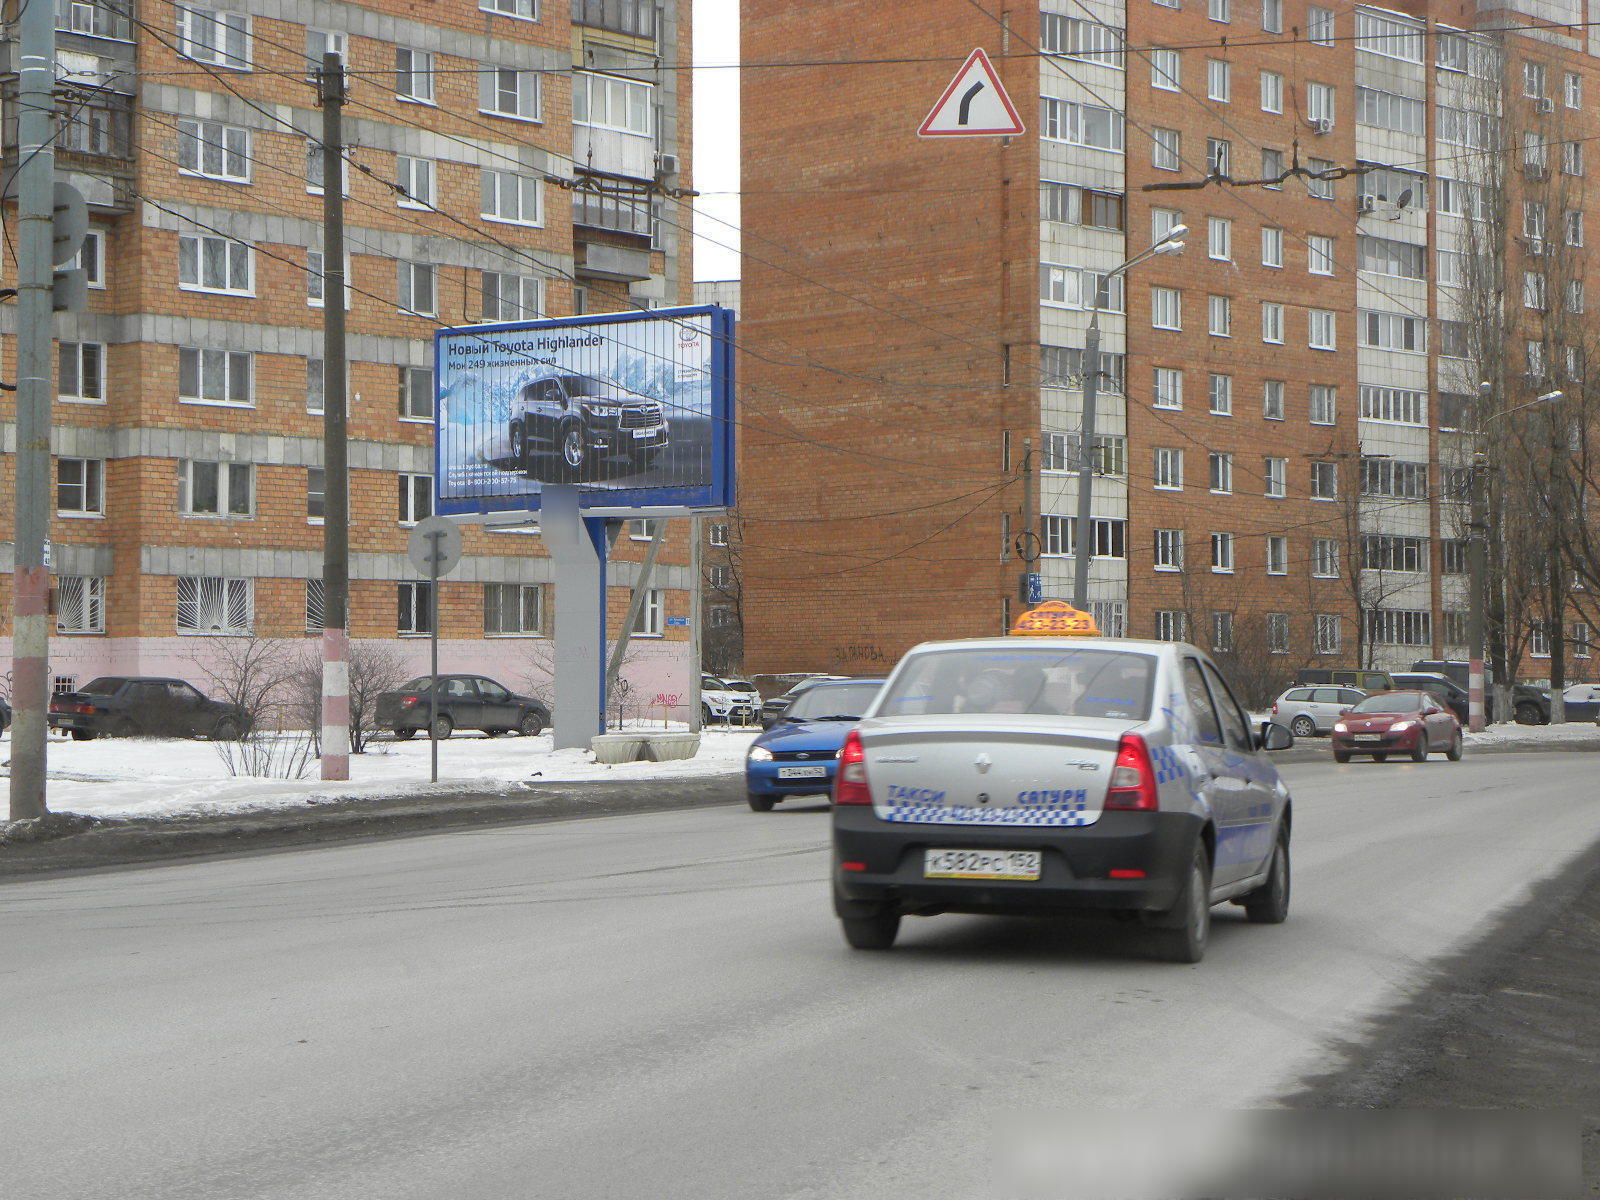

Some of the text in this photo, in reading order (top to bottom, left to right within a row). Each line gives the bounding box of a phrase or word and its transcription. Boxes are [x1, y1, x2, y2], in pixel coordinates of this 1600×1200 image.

[448, 334, 604, 356] Новый Toyota Highlander
[468, 358, 486, 370] 249
[486, 357, 539, 369] жизненных
[540, 356, 557, 366] сил
[887, 785, 947, 802] ТАКСИ
[1017, 788, 1088, 805] САТУРН
